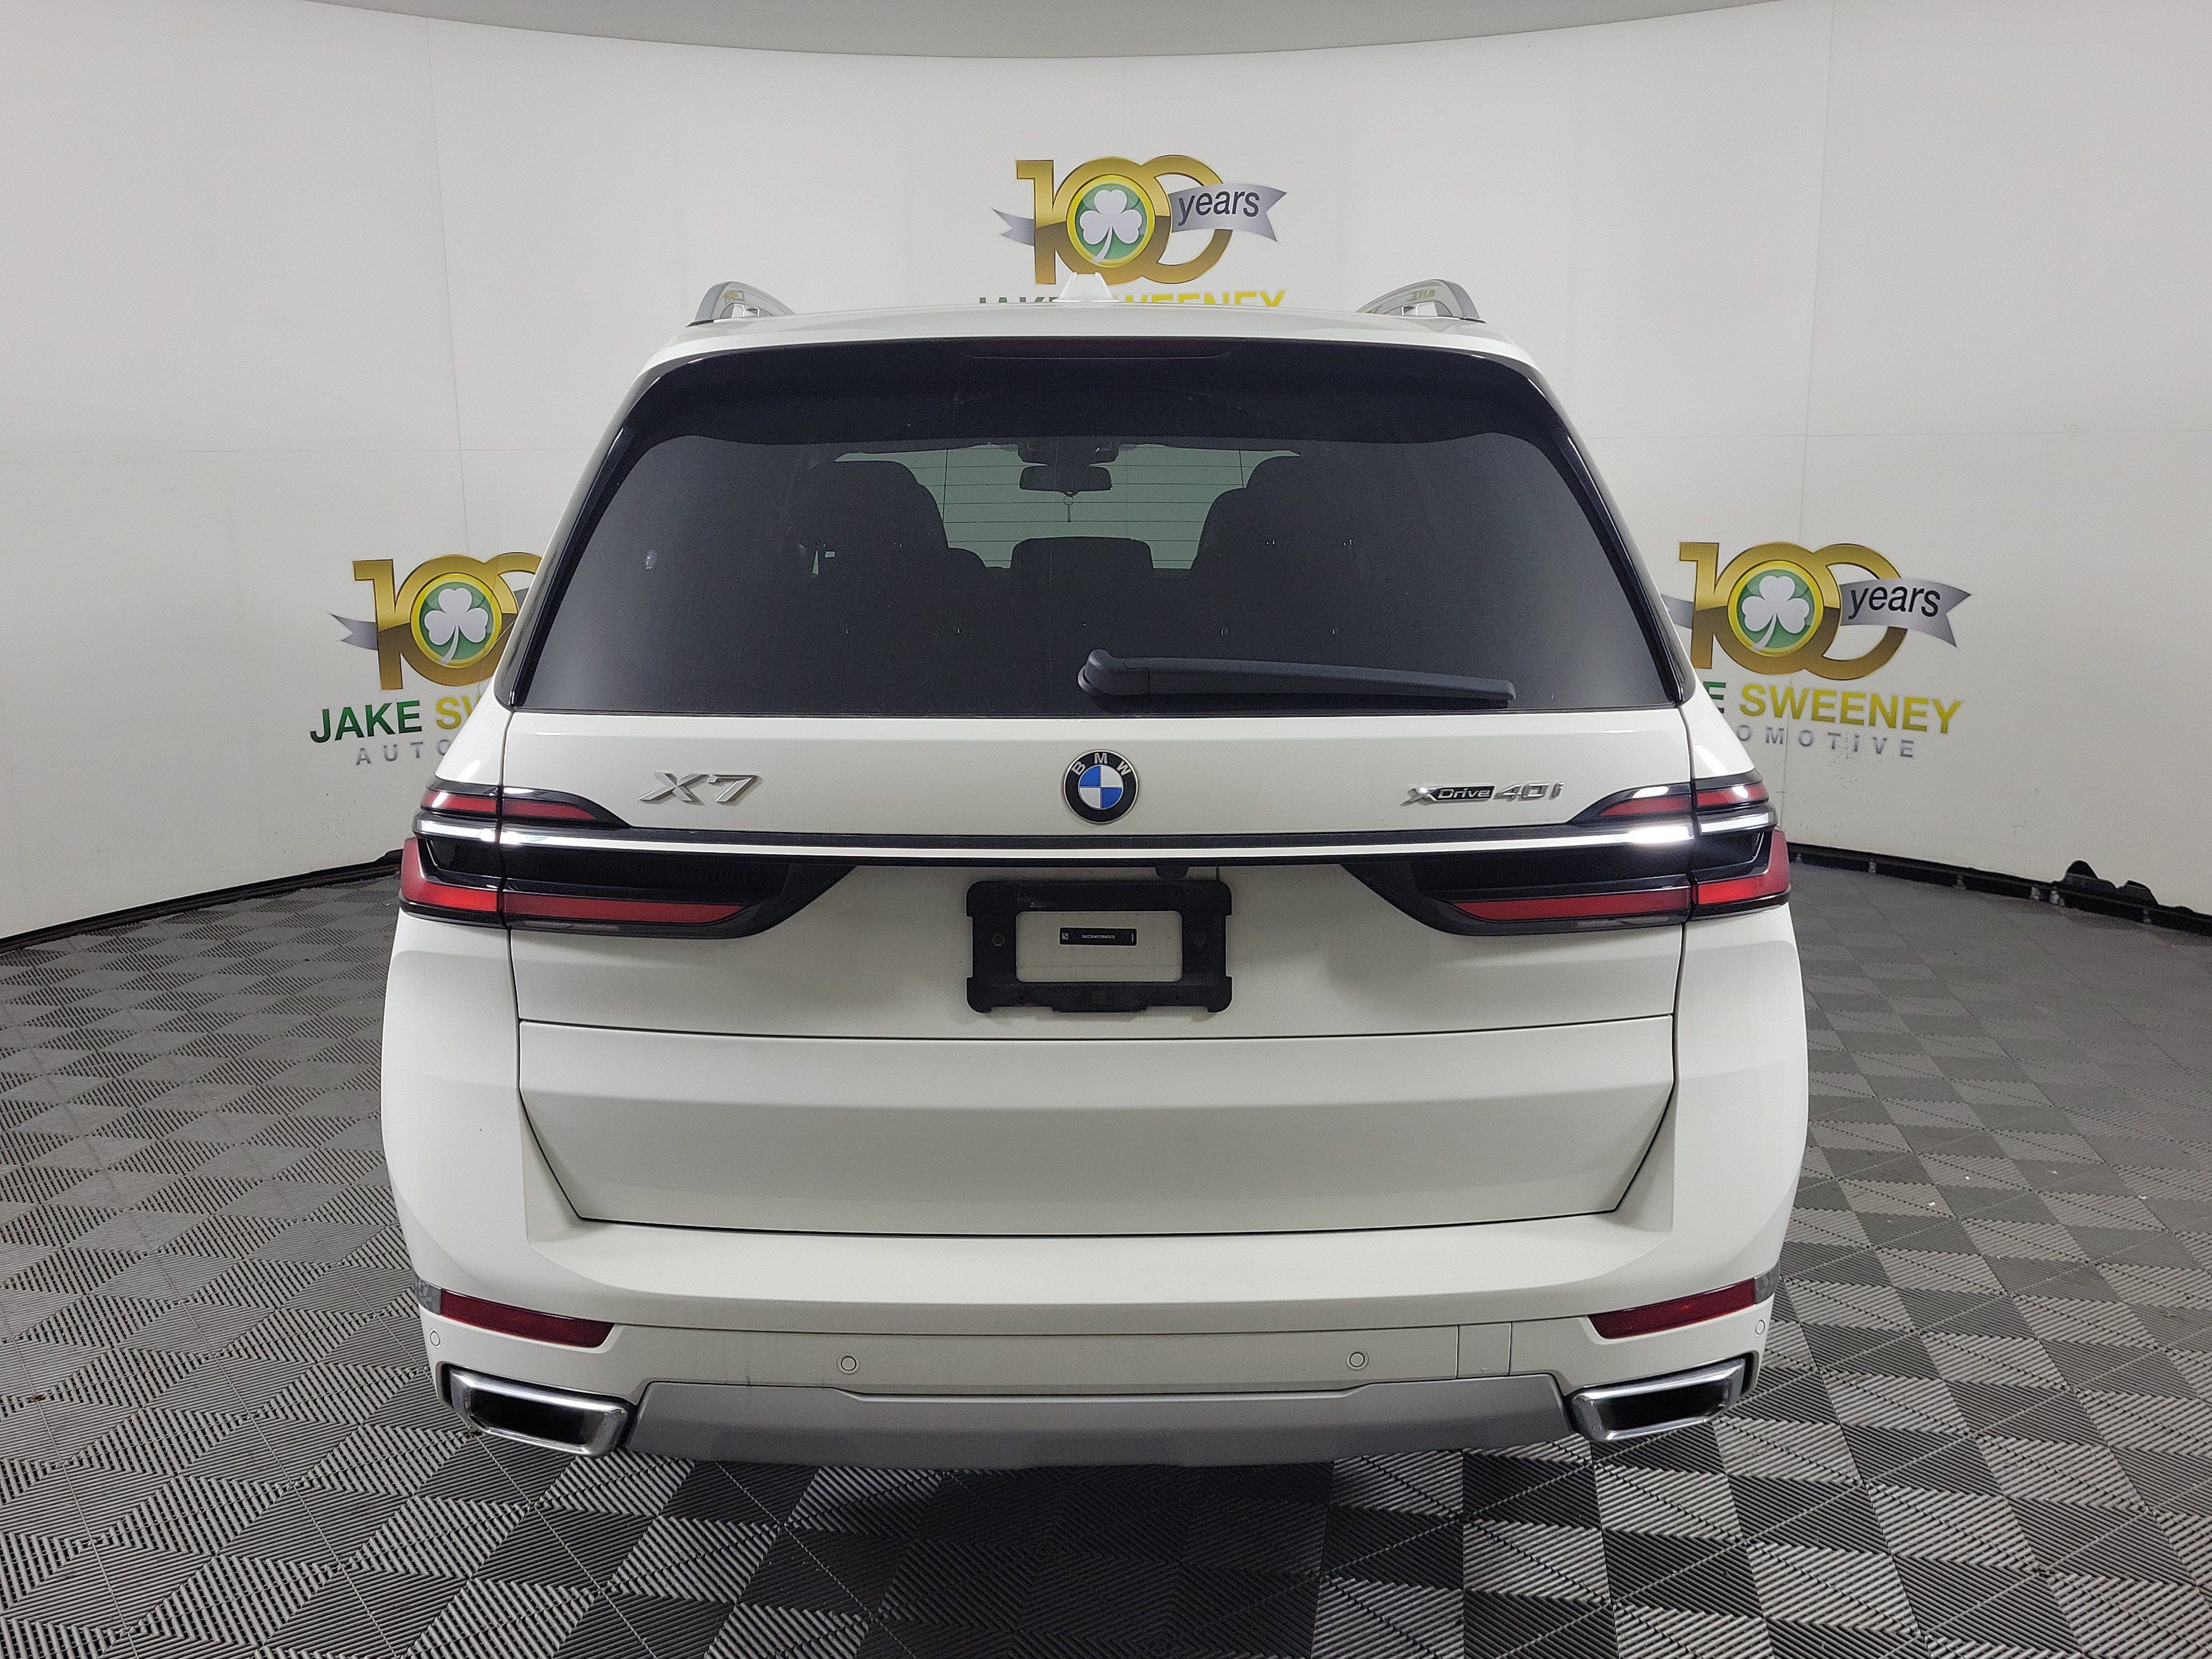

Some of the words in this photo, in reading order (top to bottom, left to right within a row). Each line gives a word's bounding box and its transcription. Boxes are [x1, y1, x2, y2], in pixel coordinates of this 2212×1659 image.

[1015, 154, 1233, 286] 100
[1178, 190, 1261, 227] years
[1679, 541, 1910, 680] 100
[1848, 585, 1942, 619] years
[309, 700, 423, 743] JAKE
[1739, 683, 1961, 734] SWEENEY
[1736, 724, 1914, 758] OMOTIVE
[1071, 753, 1131, 776] BMW
[637, 772, 758, 802] X7
